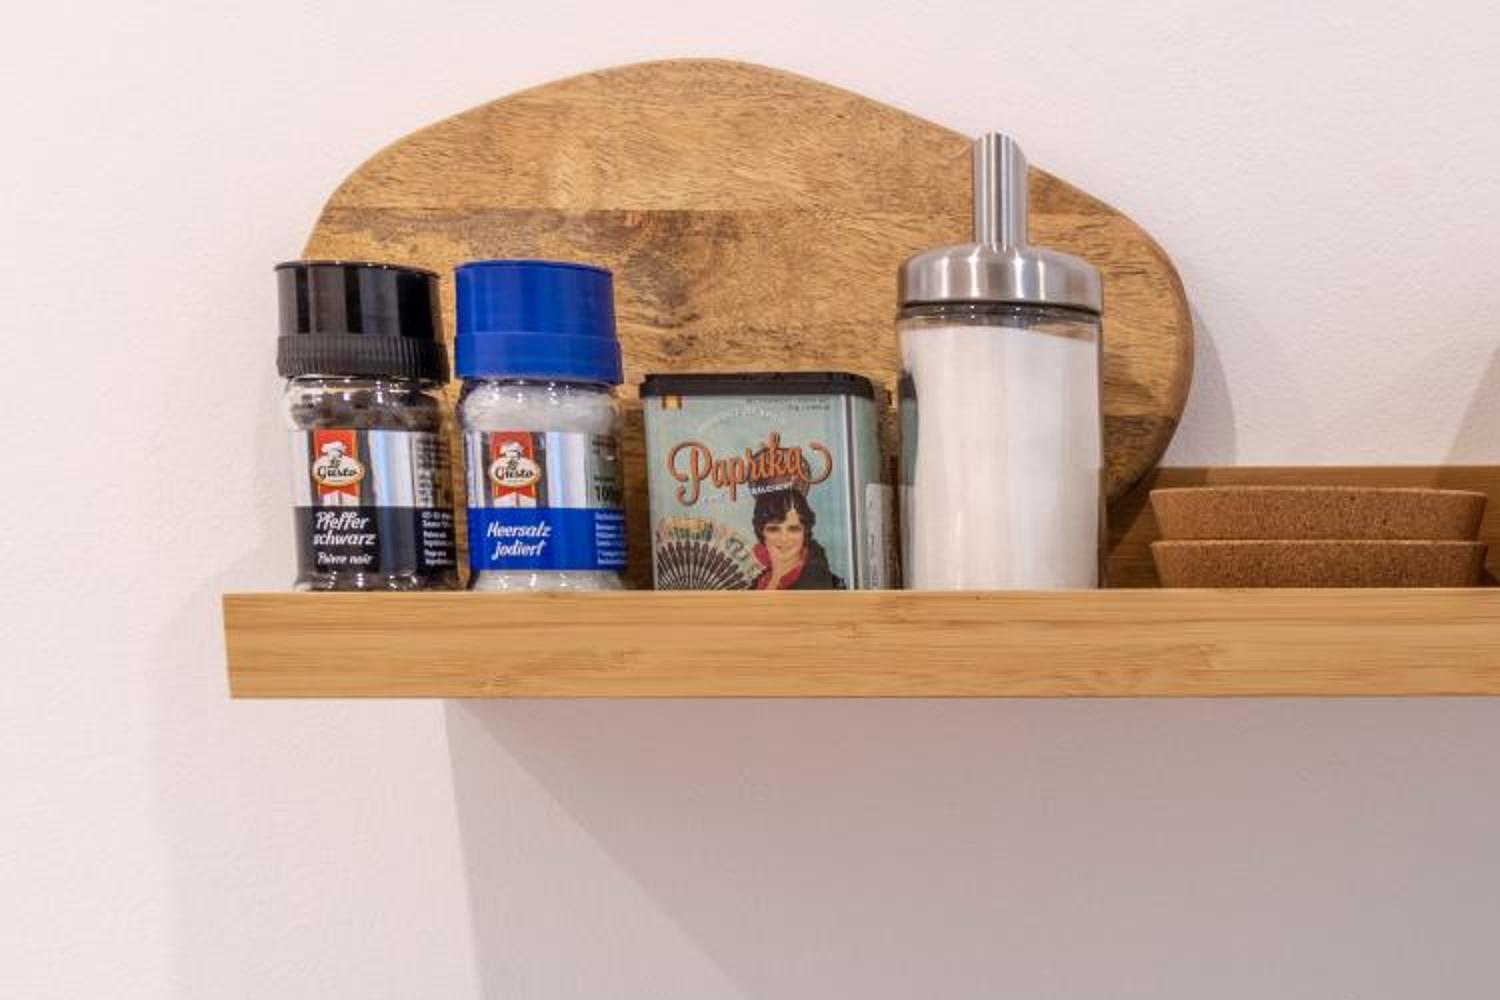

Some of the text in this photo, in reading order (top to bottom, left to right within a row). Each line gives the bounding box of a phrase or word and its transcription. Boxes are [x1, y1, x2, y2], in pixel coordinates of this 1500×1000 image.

[667, 431, 833, 506] Paprika
[315, 511, 369, 530] Pfeffer
[313, 530, 377, 546] schwarz
[491, 539, 547, 561] jodiert
